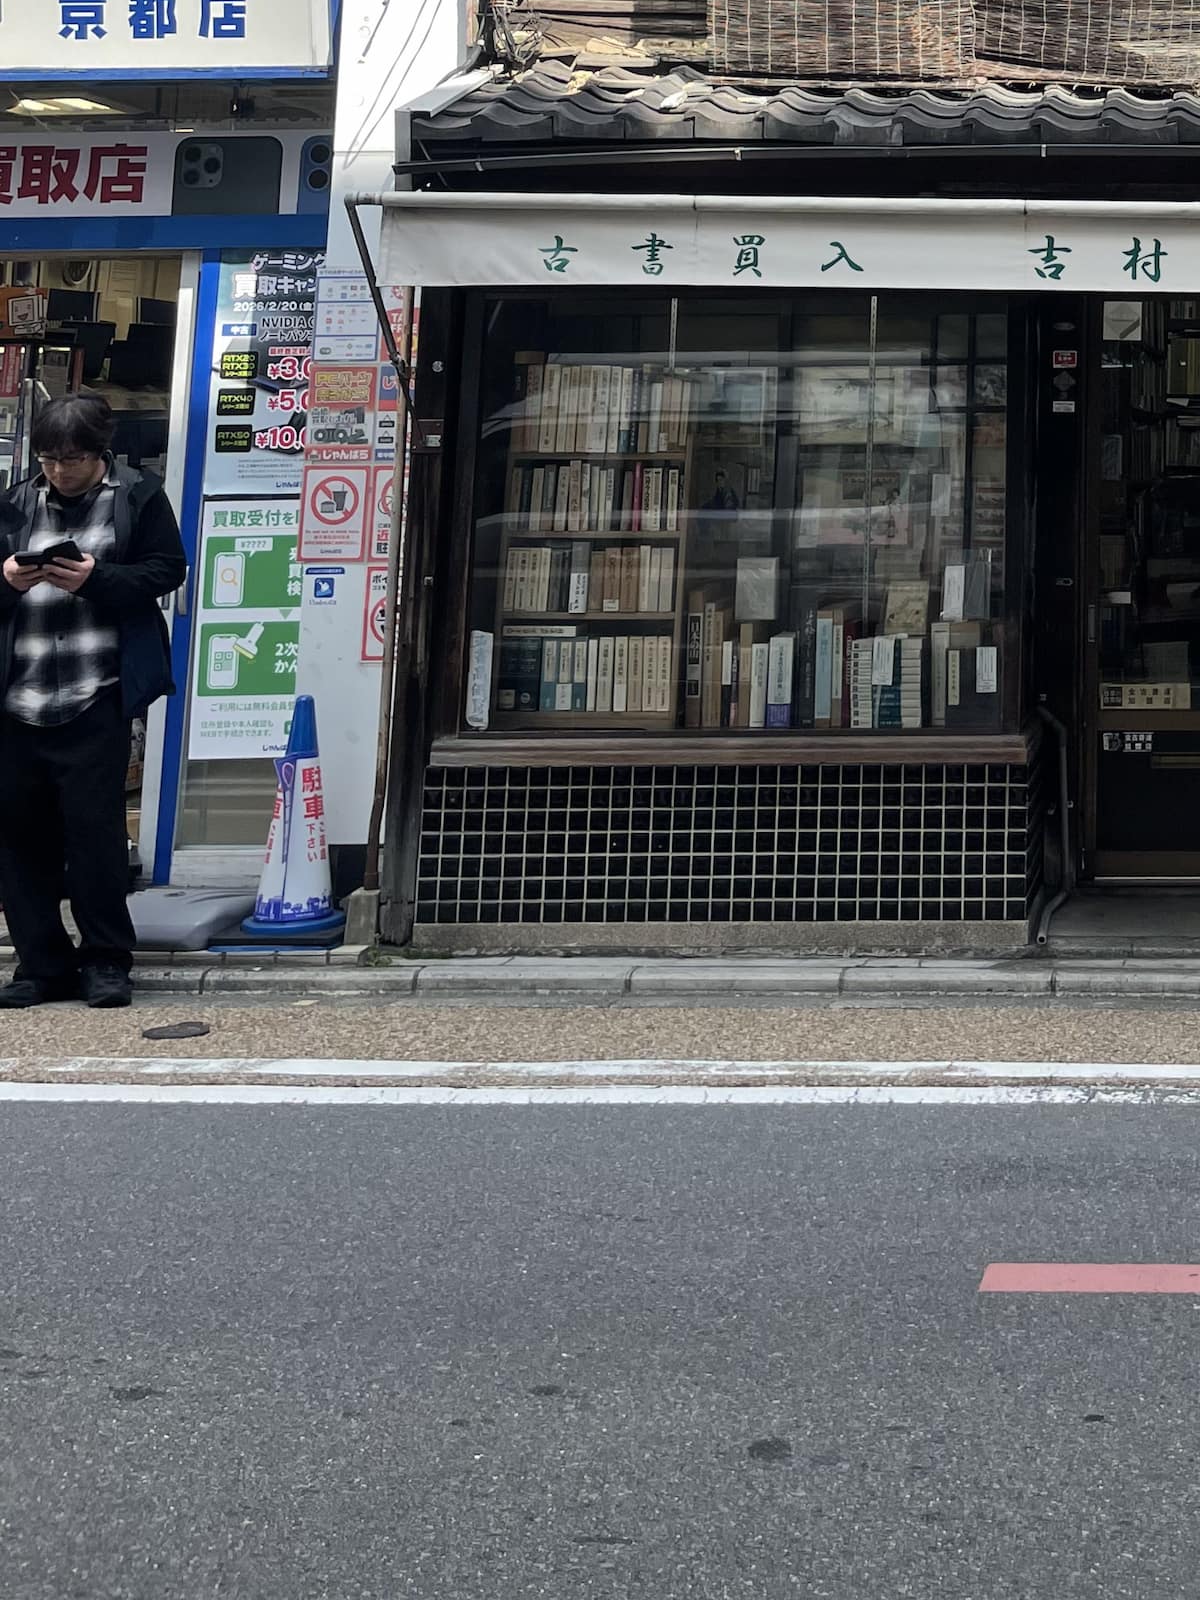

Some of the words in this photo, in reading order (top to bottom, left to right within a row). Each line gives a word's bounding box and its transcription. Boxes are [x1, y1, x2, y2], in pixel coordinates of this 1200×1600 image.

[538, 234, 864, 278] 古書買入
[262, 317, 308, 328] NVIDIA
[219, 394, 253, 403] RTX40
[213, 510, 299, 527] 買取受付を
[306, 823, 318, 863] 下さい
